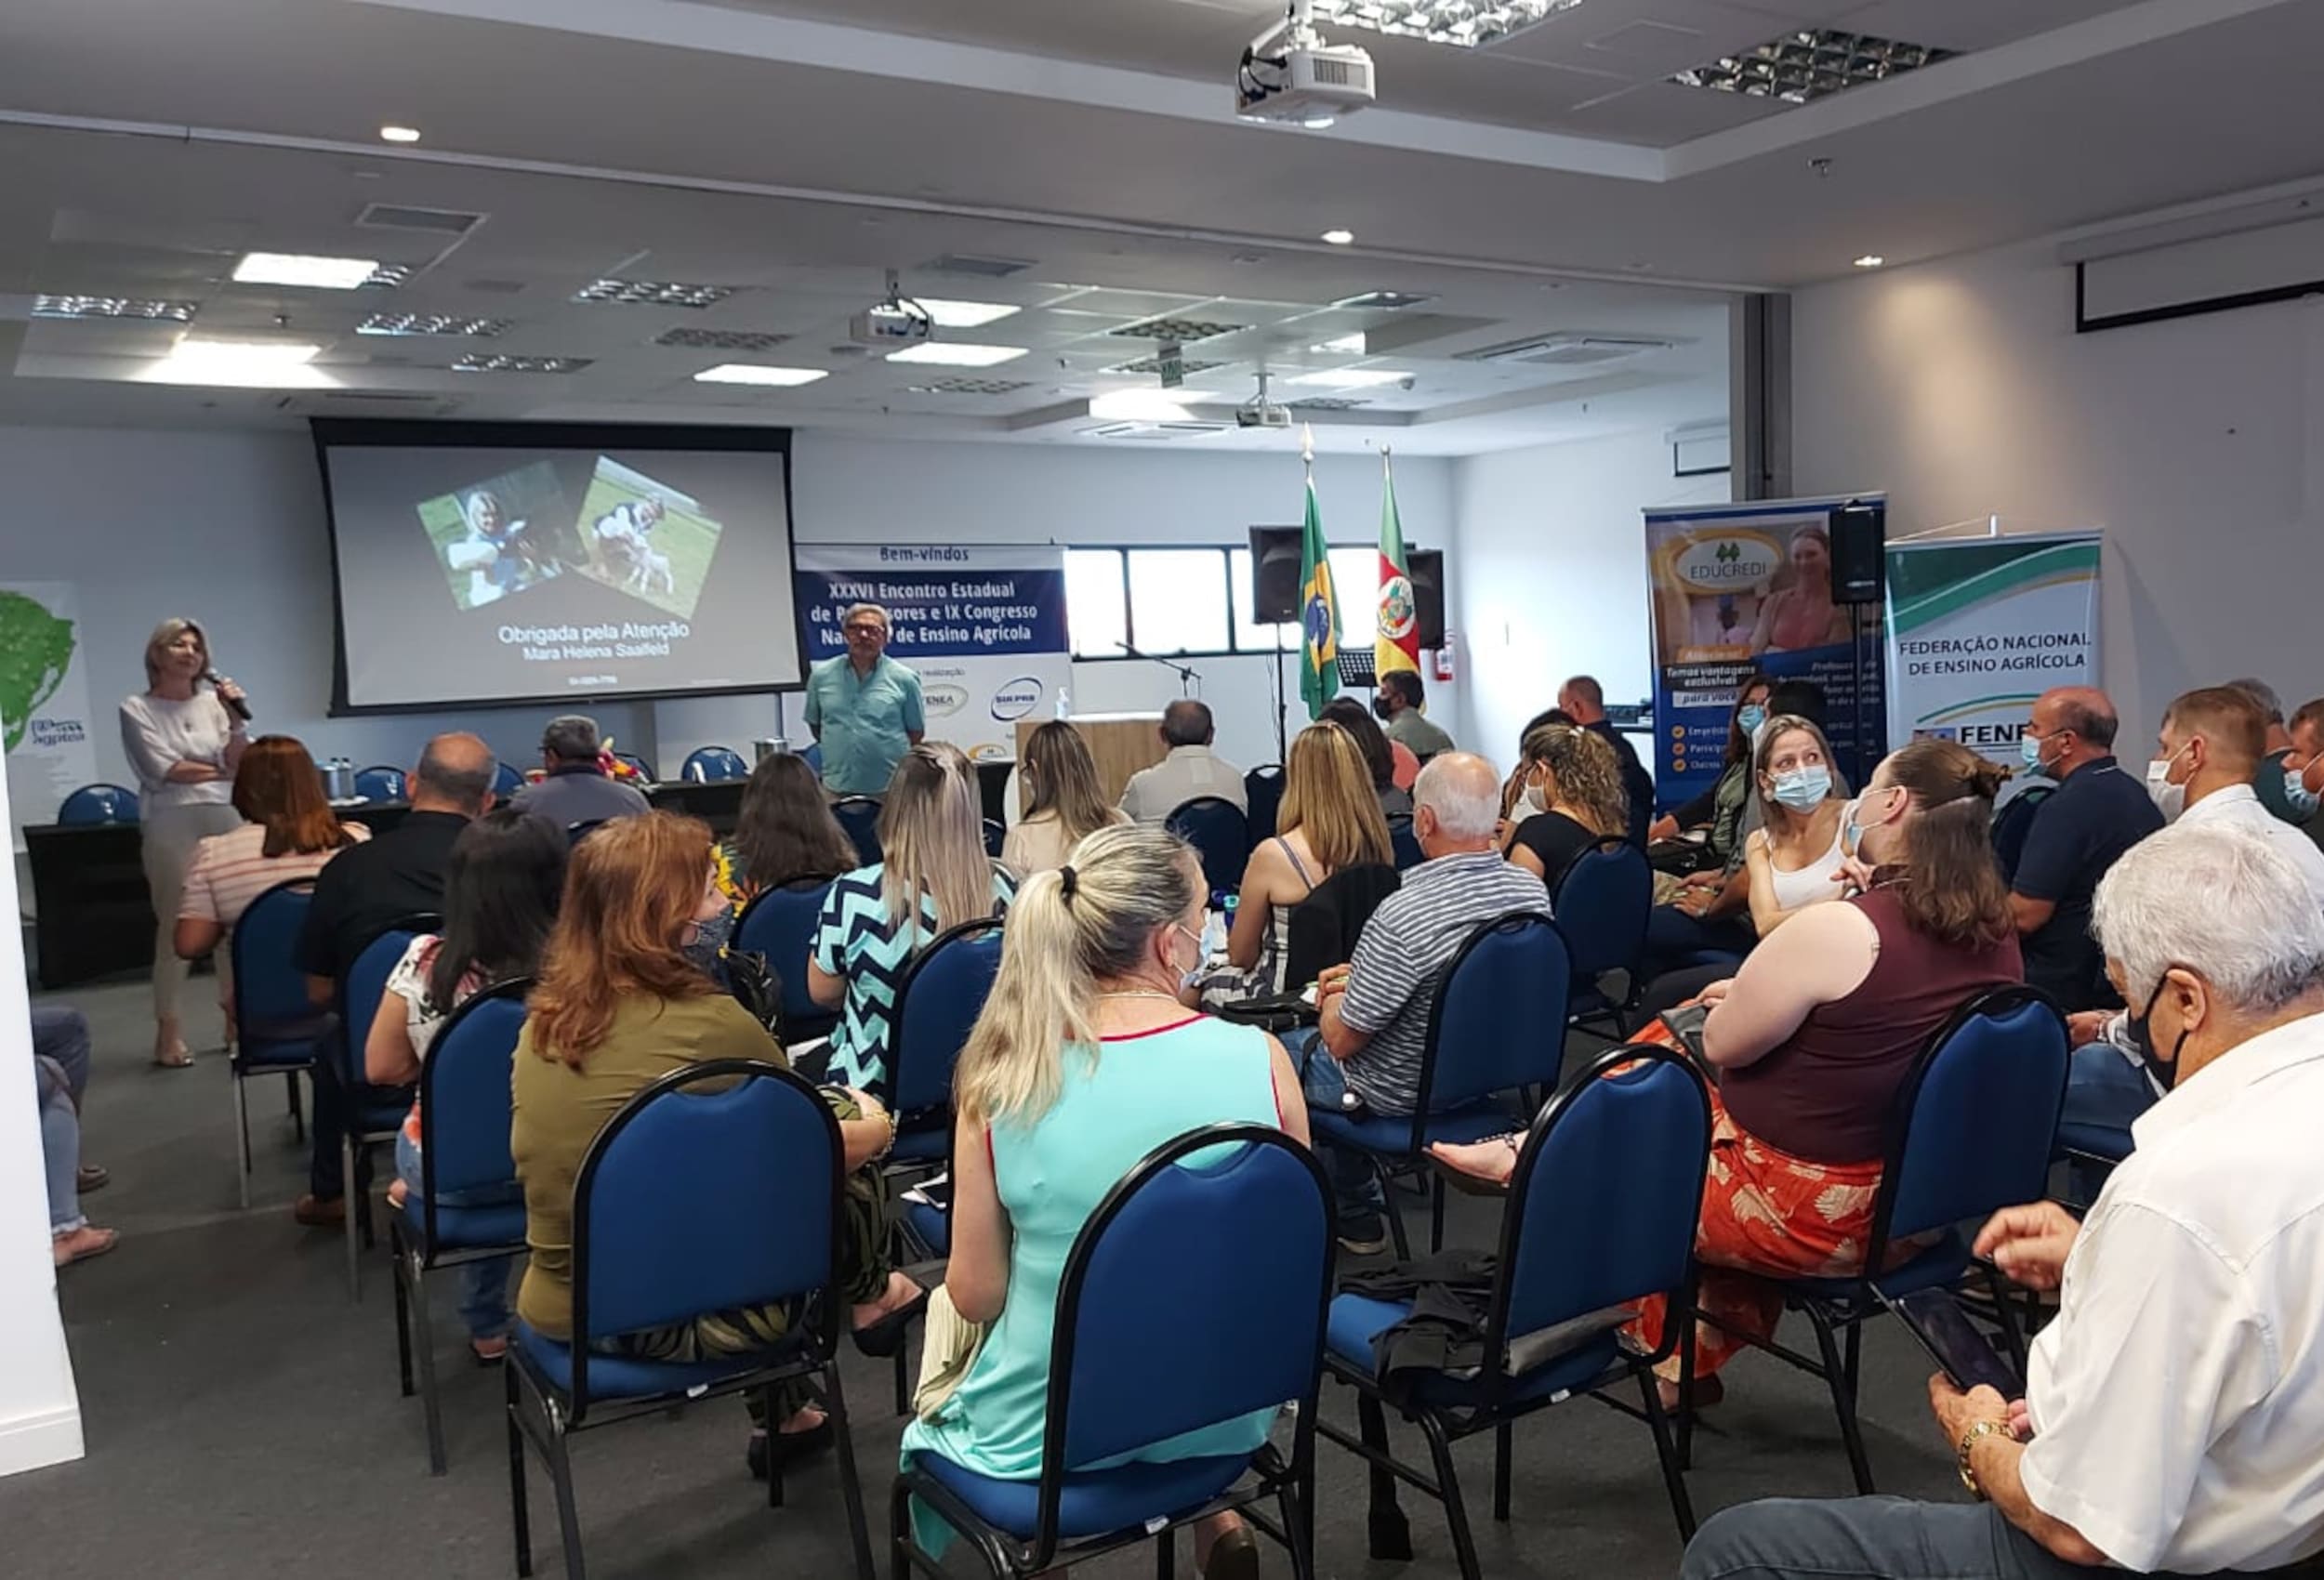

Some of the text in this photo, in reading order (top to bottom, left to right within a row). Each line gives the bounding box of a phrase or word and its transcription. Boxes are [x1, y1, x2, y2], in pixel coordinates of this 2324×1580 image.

[879, 546, 970, 561] Bem-vindos
[1690, 561, 1766, 580] EDUCREDI
[828, 581, 1015, 599] XXXVI Encontro Estadual
[811, 606, 831, 623] de
[931, 607, 941, 620] e
[944, 605, 960, 620] IX
[964, 604, 1038, 625] Congresso
[498, 621, 690, 646] Obrigada pela Atenção
[895, 627, 916, 643] de
[919, 625, 969, 642] Ensino
[973, 625, 1032, 646] Agrícola
[522, 647, 561, 661] Mara
[562, 645, 613, 659] Helena
[1899, 633, 2092, 655] FEDERAÇÃO NACIONAL
[1908, 653, 2085, 676] DE ENSINO AGRÍCOLA
[1681, 693, 1710, 704] para
